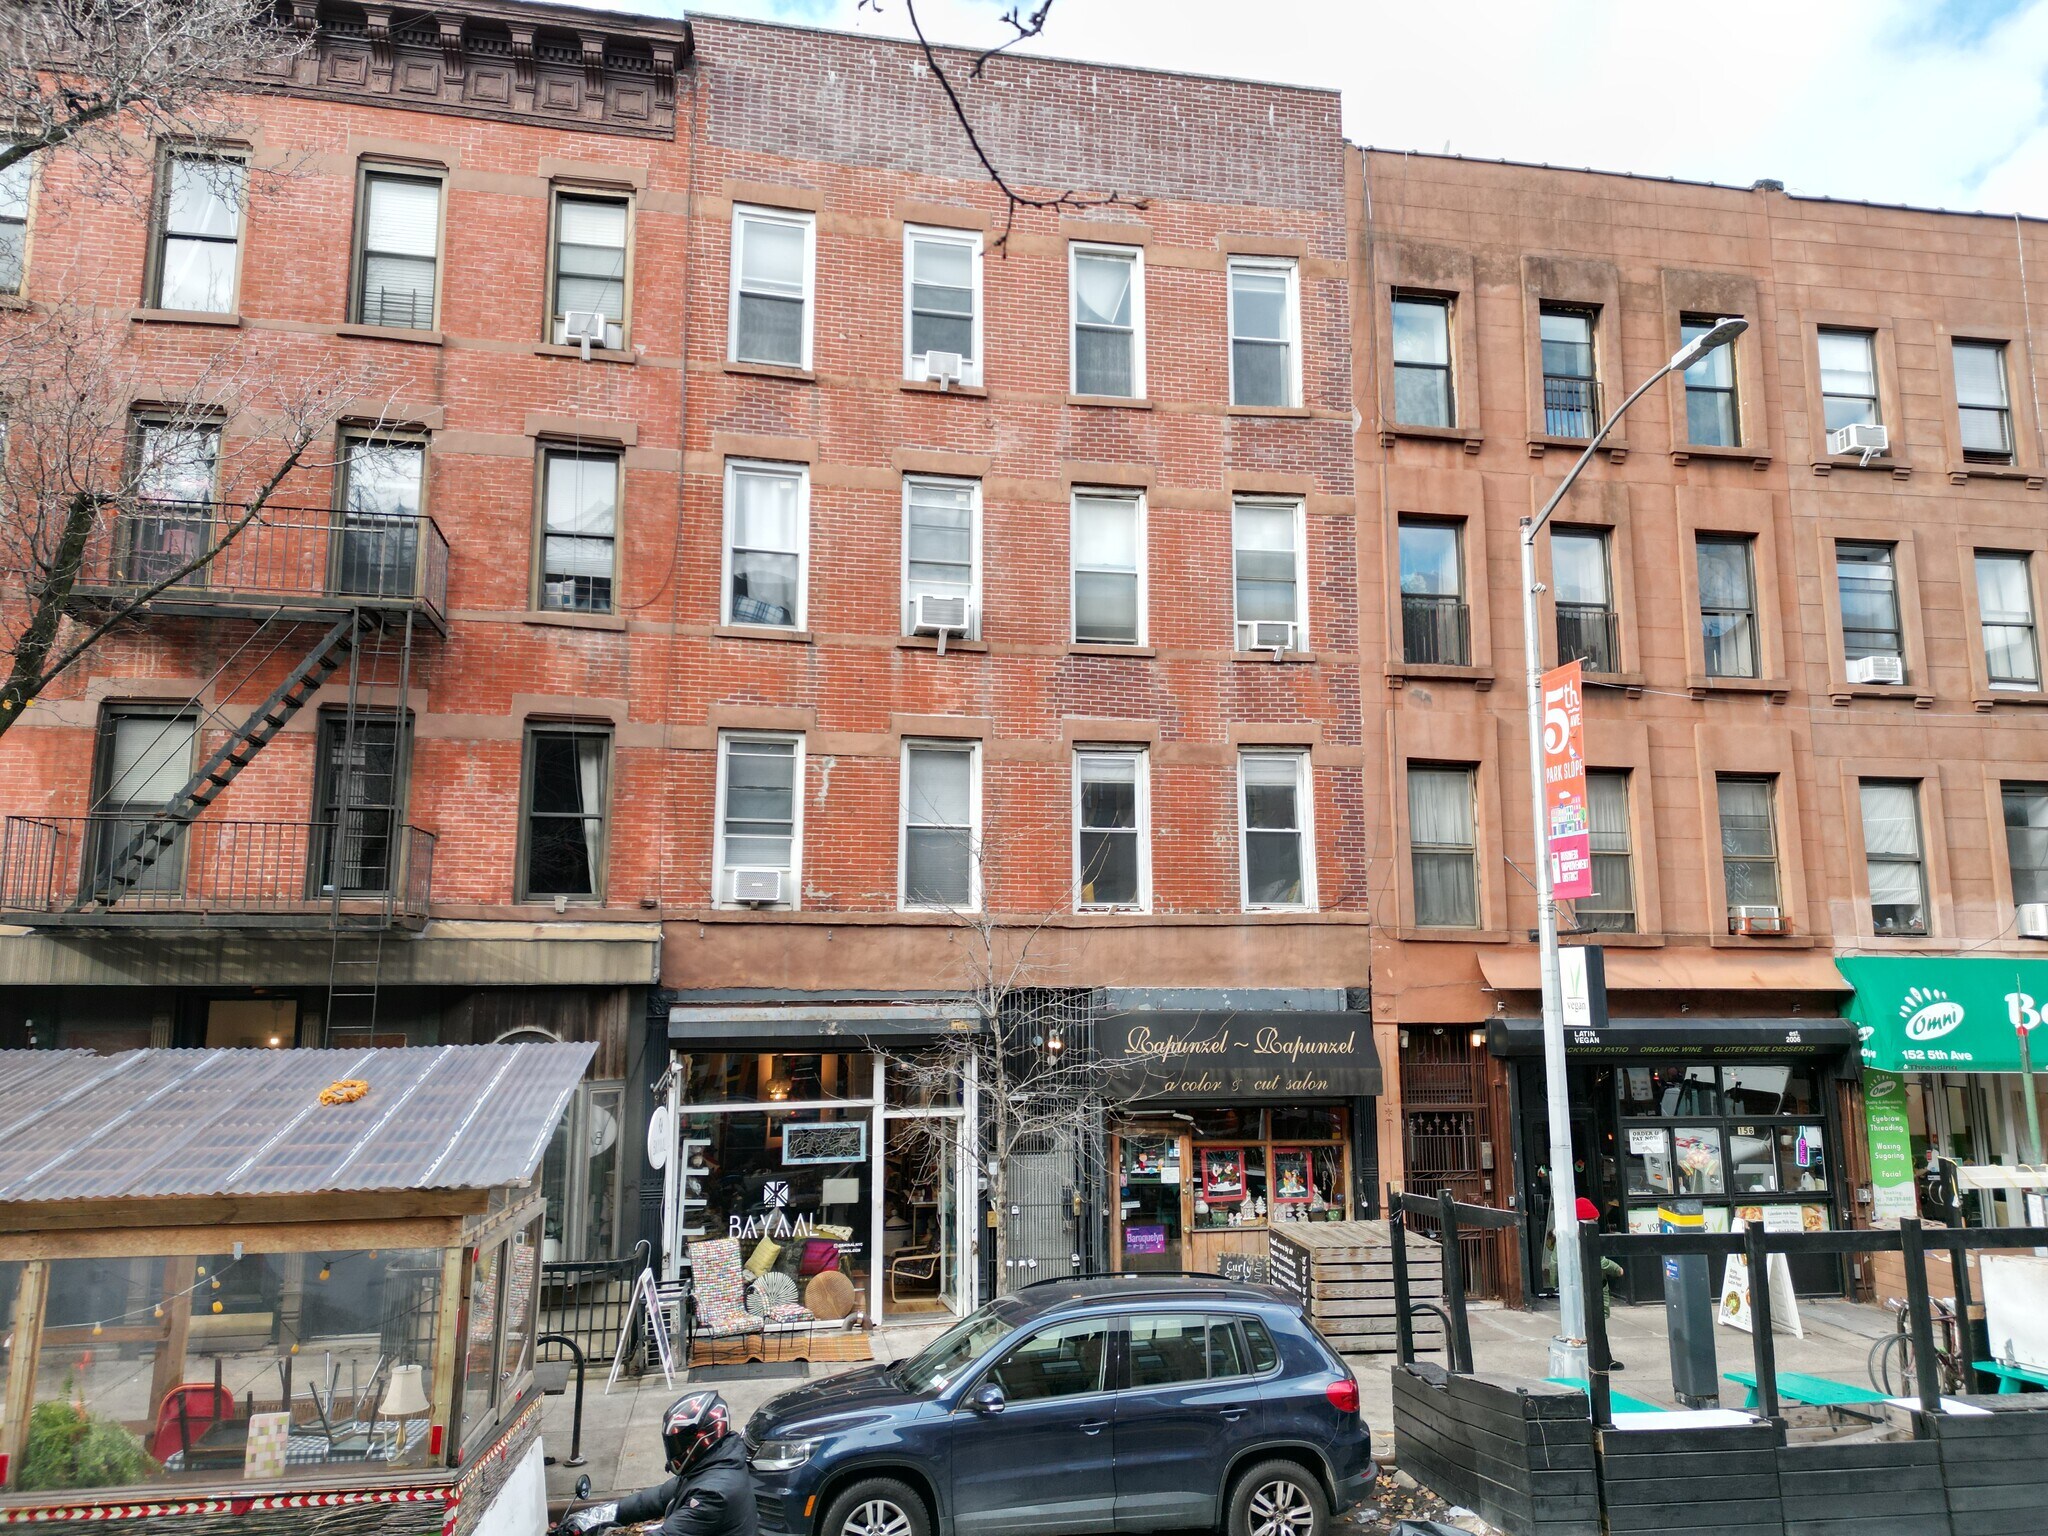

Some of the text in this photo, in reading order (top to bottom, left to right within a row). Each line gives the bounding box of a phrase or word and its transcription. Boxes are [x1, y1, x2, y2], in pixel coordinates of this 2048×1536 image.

[1545, 681, 1580, 754] 5th
[1546, 758, 1584, 784] PARK SLOPE
[1567, 1001, 1586, 1012] vegan
[1912, 1006, 1957, 1036] Omni
[1124, 1026, 1228, 1063] Rapunzel
[1254, 1026, 1356, 1063] Rapunzel
[1902, 1050, 1973, 1061] 152 5th Ave
[1165, 1080, 1177, 1092] a
[1181, 1071, 1222, 1092] color
[1254, 1074, 1280, 1091] cut
[1285, 1071, 1328, 1092] salon
[1872, 1115, 1900, 1123] Eyebrow
[1739, 1127, 1754, 1135] 156
[1870, 1124, 1904, 1133] Threading
[1876, 1143, 1901, 1151] Waxing
[1875, 1152, 1905, 1161] Sugaring
[1881, 1170, 1902, 1178] Facial
[729, 1212, 819, 1239] BAYAAL
[1127, 1233, 1164, 1243] Baroquelyn
[1227, 1261, 1251, 1278] Curly
